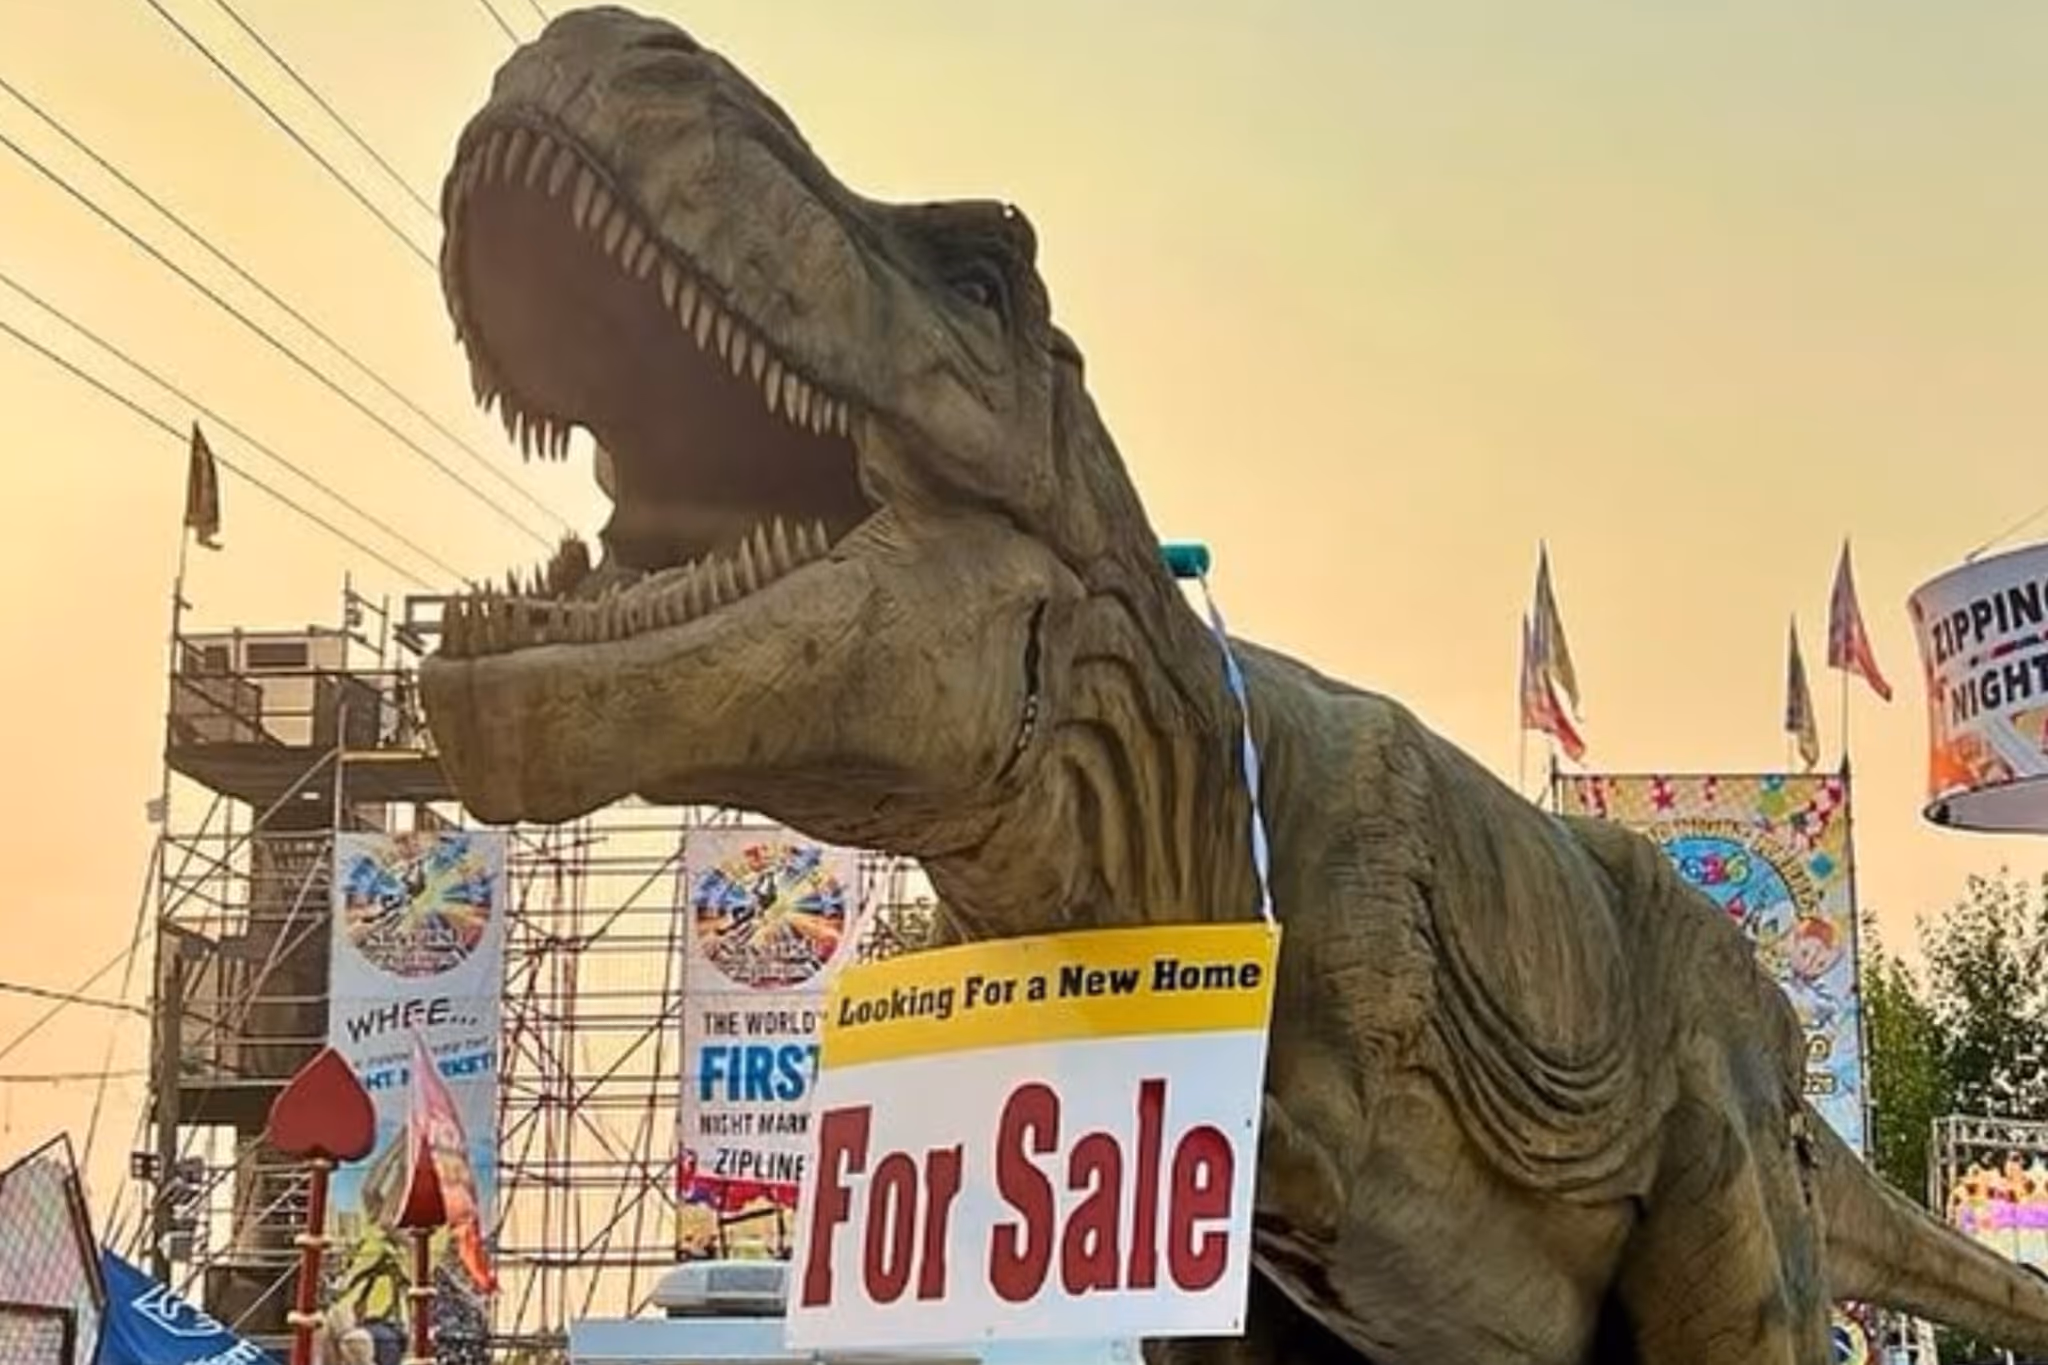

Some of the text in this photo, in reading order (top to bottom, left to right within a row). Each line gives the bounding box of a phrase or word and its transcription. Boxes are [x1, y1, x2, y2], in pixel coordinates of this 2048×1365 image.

[1932, 580, 2048, 666] ZIPPIN
[704, 1011, 739, 1035] THE
[838, 959, 1262, 1027] Looking For a New Home
[700, 1112, 753, 1136] NIGHT
[801, 1078, 1235, 1308] For Sale
